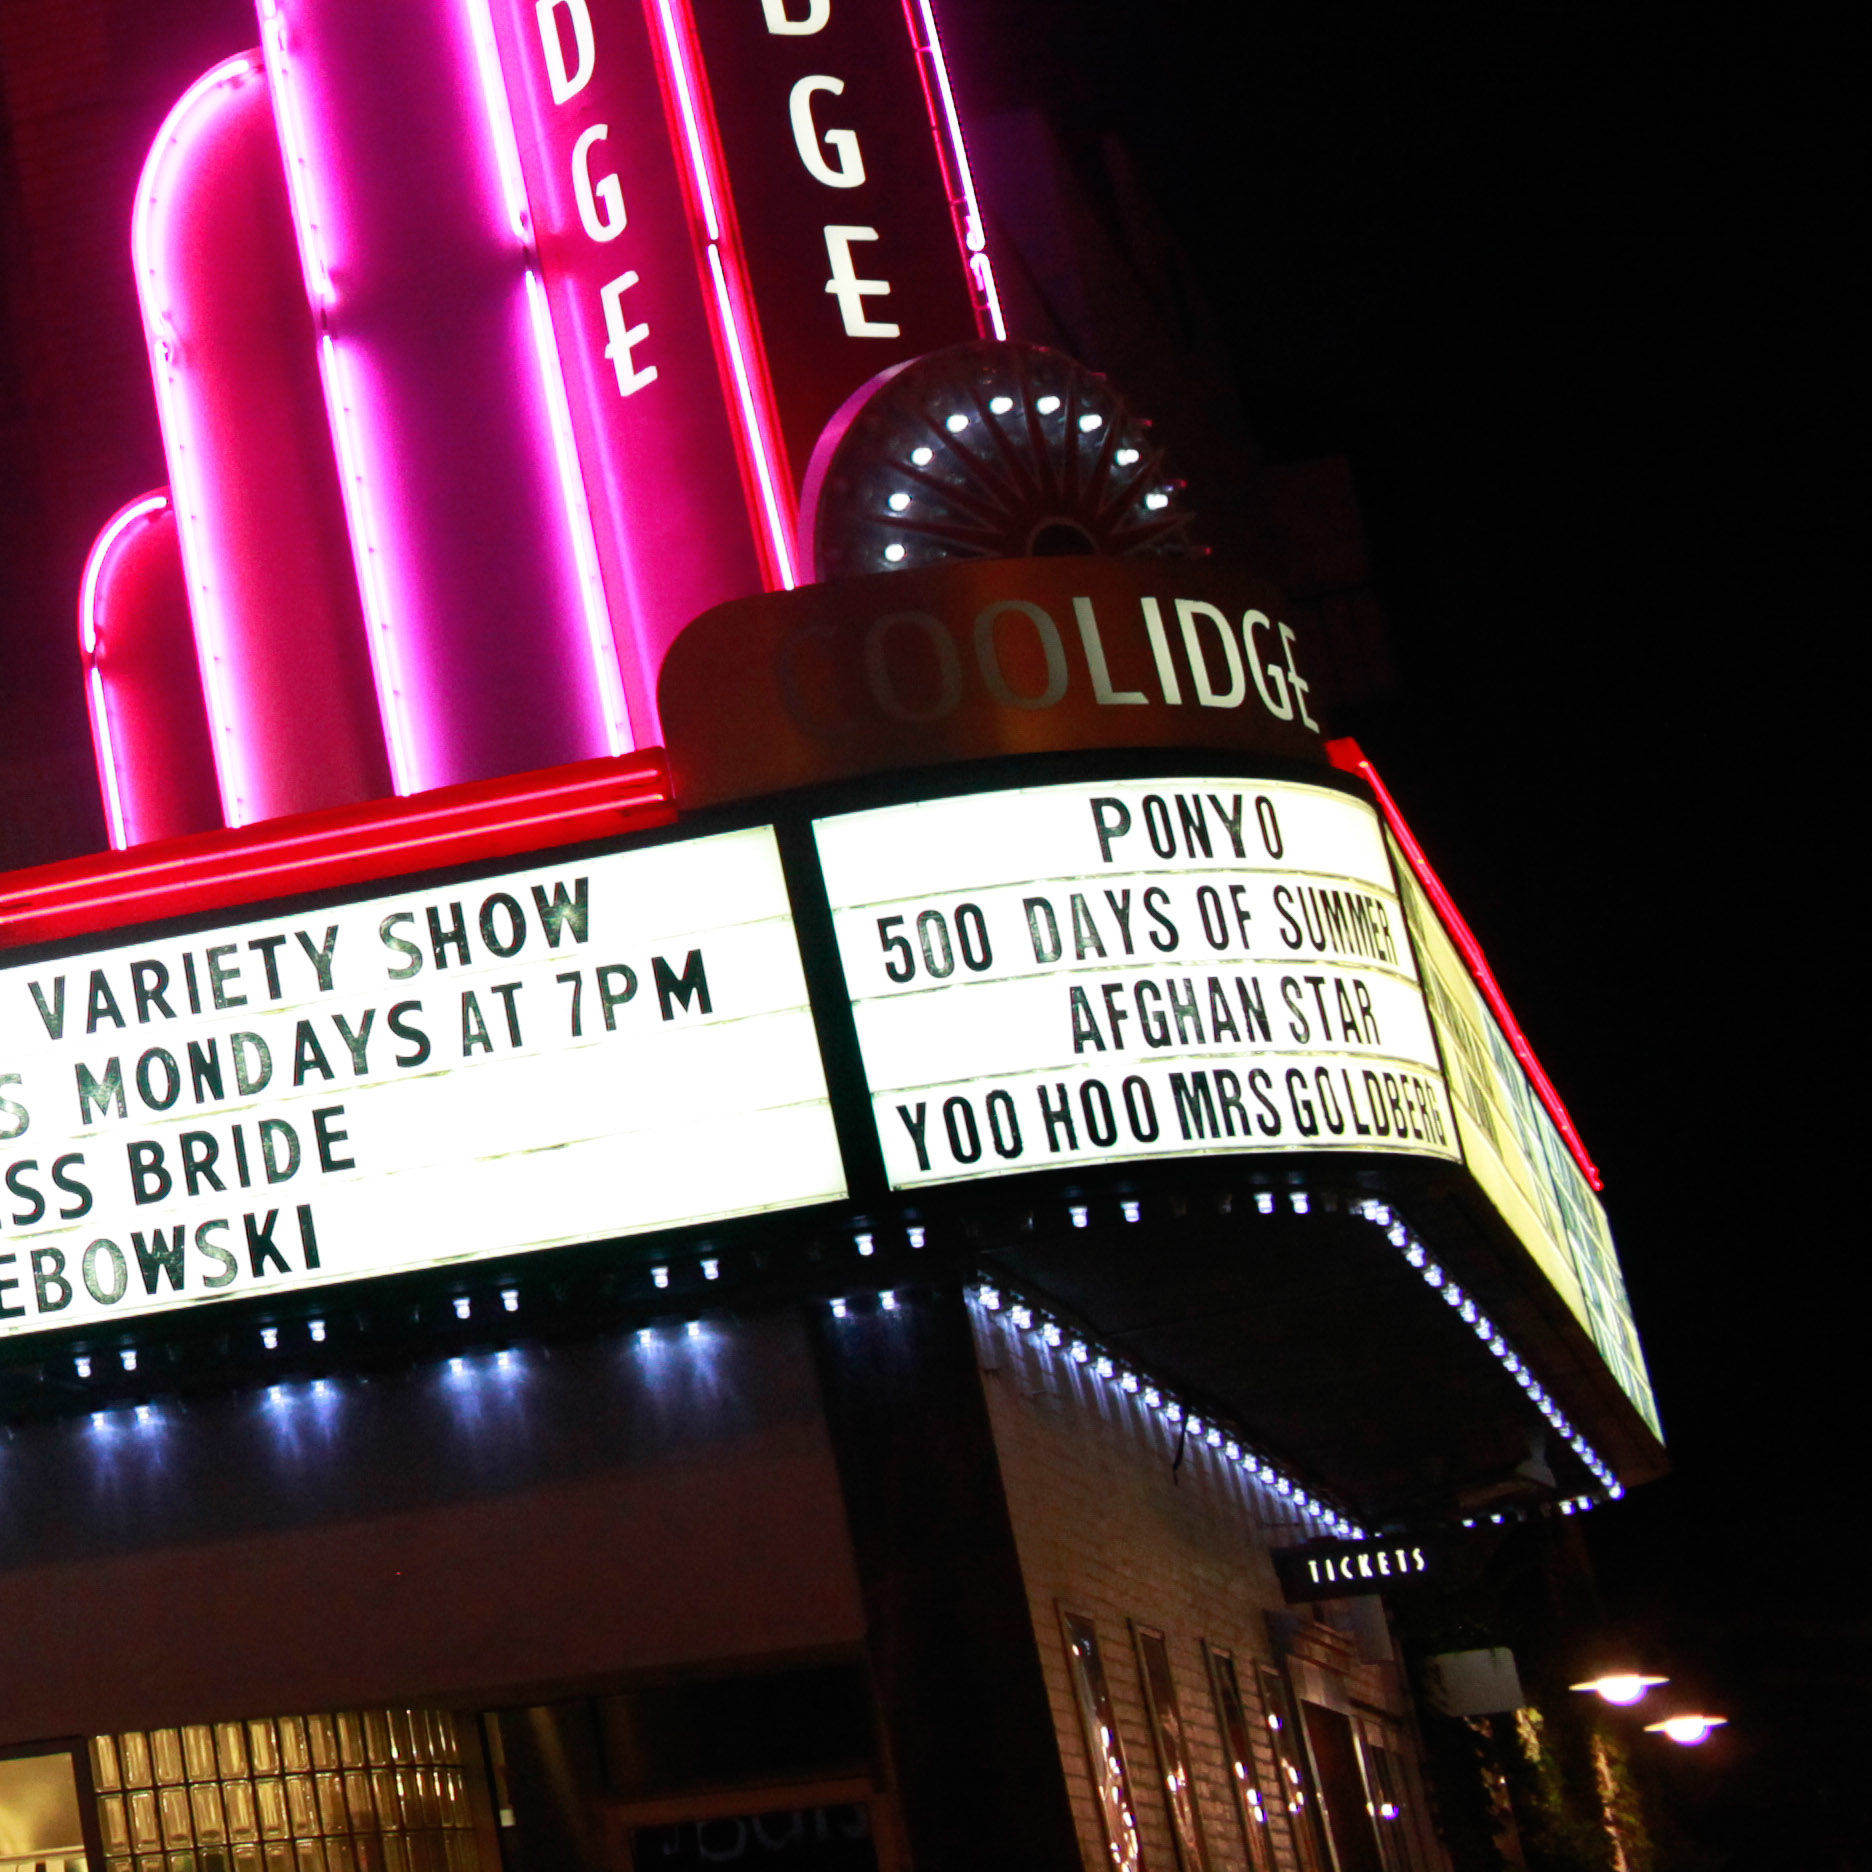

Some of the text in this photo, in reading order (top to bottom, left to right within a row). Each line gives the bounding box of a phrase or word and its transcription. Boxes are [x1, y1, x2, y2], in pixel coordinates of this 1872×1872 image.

[776, 594, 1321, 735] COOLIDGE
[1089, 792, 1285, 863] PONYO
[27, 924, 338, 1041] VARIETY
[378, 876, 590, 980] SHOW
[877, 883, 1399, 984] 500 DAYS OF SUMMER
[75, 1000, 431, 1124] MONDAYS
[460, 981, 526, 1057] AT
[1069, 973, 1383, 1054] AFGHAN STAR
[126, 1104, 356, 1206] BRIDE
[895, 1064, 1448, 1172] YOO HOO MRS GOLDBERG
[1308, 1547, 1426, 1584] TICKETS
